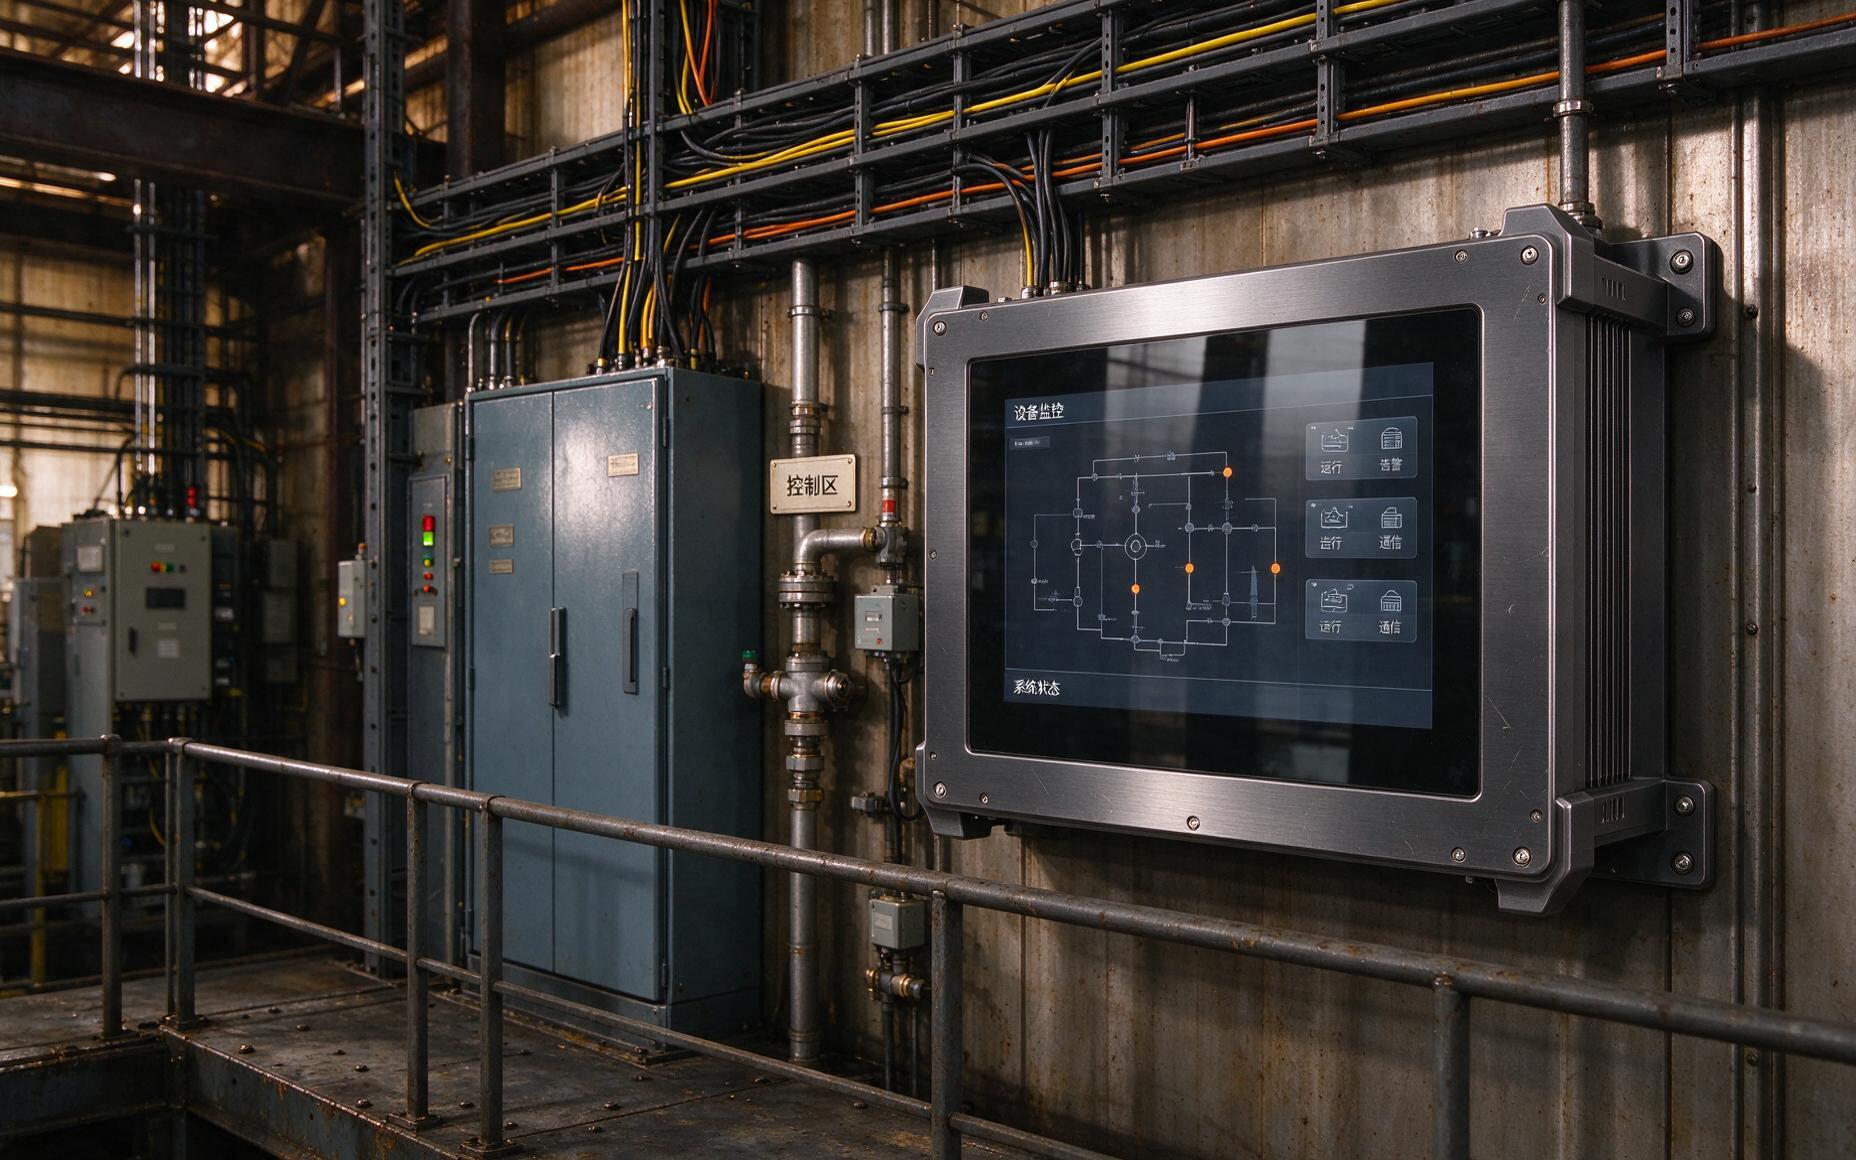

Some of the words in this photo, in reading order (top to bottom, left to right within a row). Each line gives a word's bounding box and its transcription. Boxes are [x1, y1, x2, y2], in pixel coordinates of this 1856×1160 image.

[1014, 402, 1064, 421] 设备监控
[787, 474, 839, 496] 控制区
